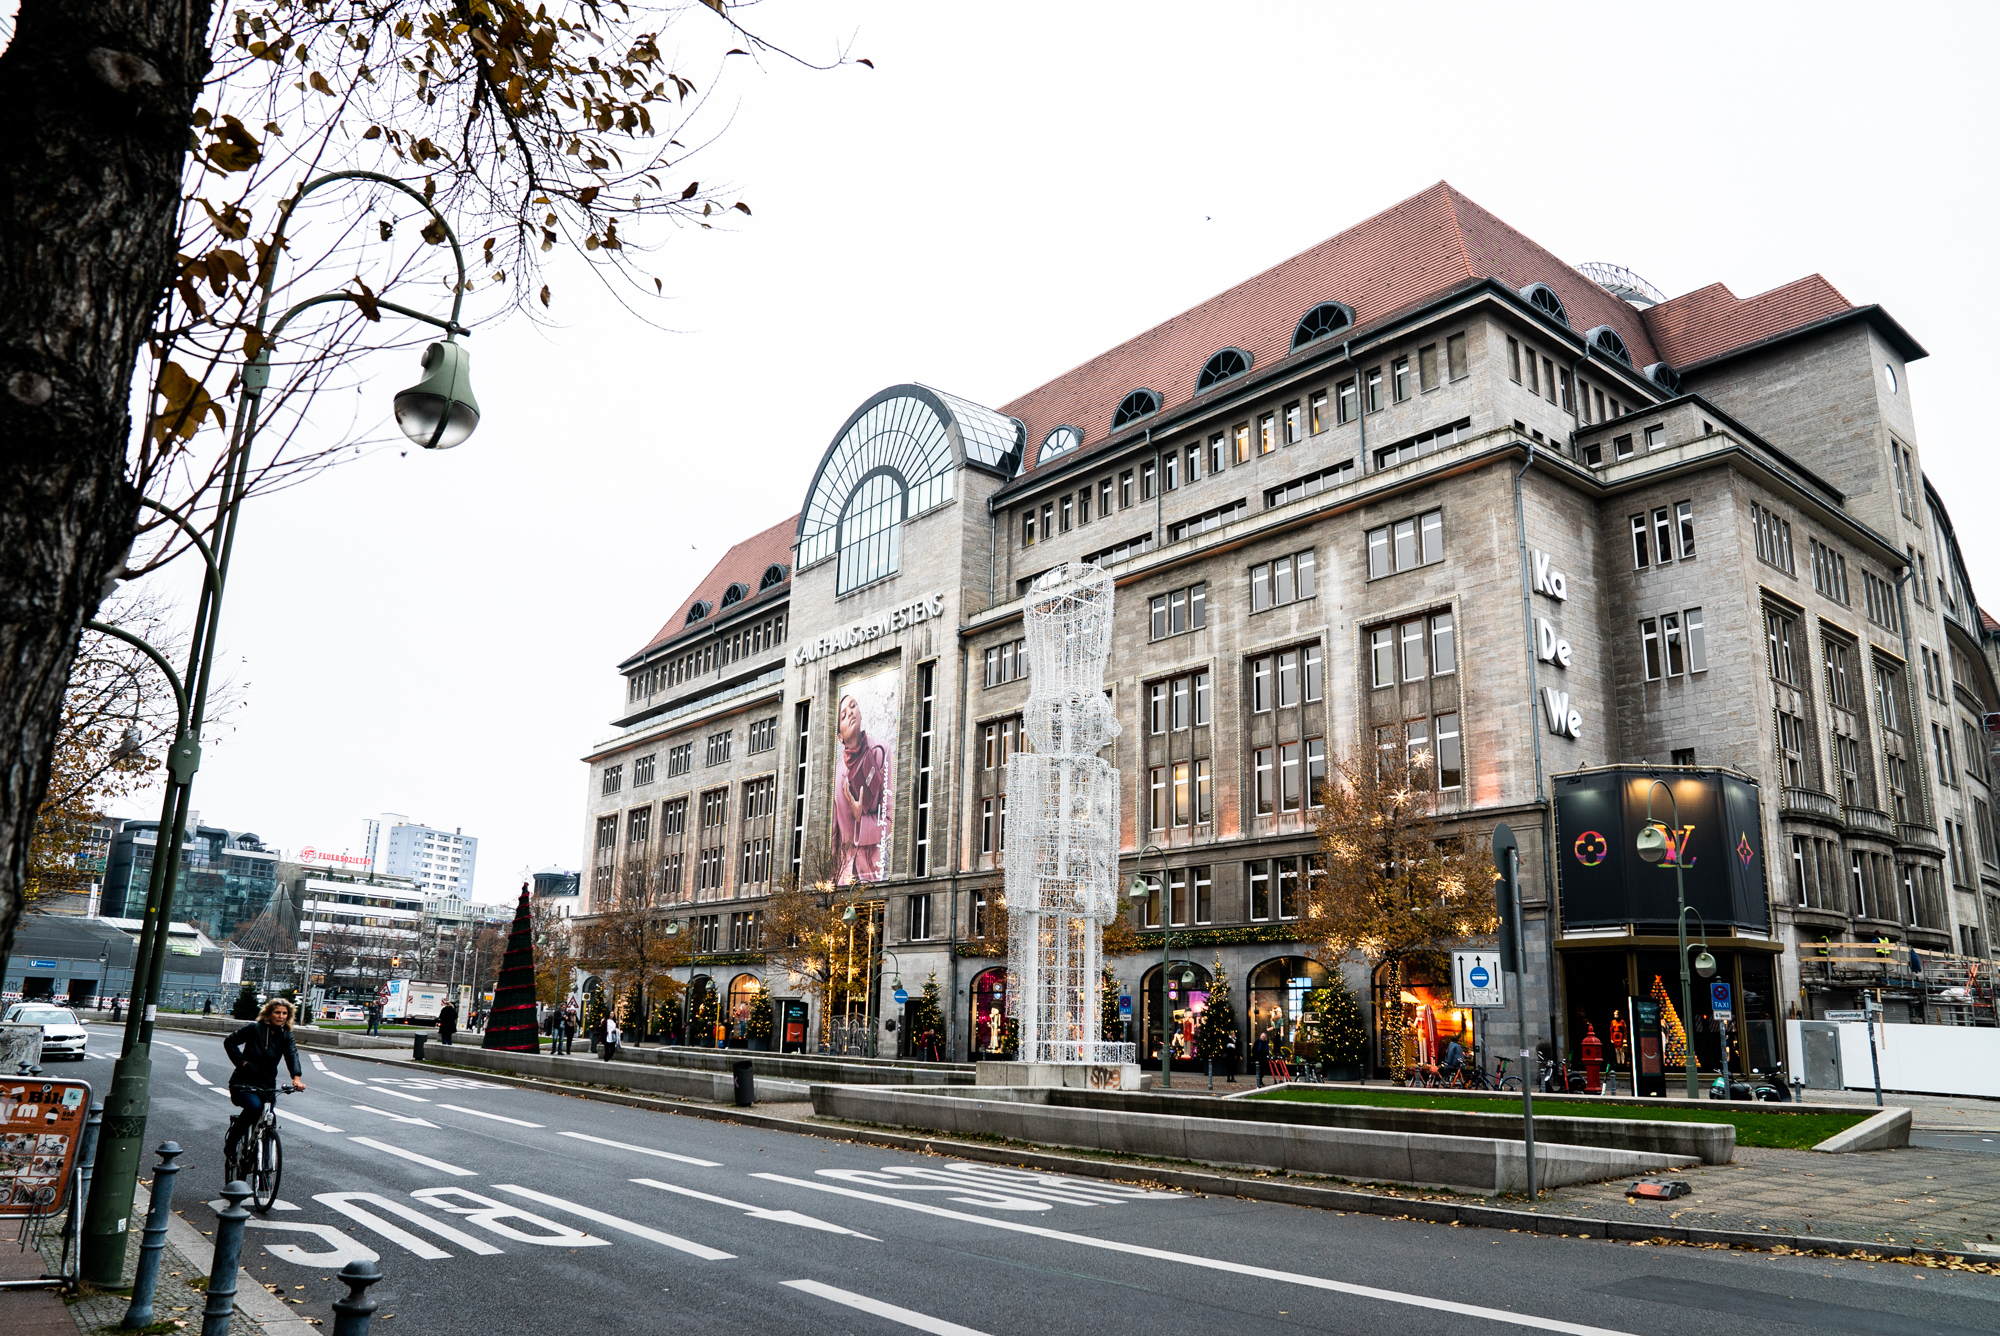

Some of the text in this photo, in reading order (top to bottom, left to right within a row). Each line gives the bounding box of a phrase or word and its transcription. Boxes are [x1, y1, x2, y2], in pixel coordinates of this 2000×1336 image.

[1530, 548, 1567, 602] Ka
[793, 592, 944, 667] KAUFHAUS DES WESTENS
[1535, 617, 1573, 668] De
[1541, 686, 1583, 739] We
[874, 754, 892, 881] Salvatore Ferragamo
[318, 852, 371, 865] FEUERSOZIETÄT
[28, 1091, 64, 1104] Bik
[367, 1078, 516, 1090] BUS
[814, 1163, 1190, 1211] BUS
[207, 1186, 613, 1269] BUS
